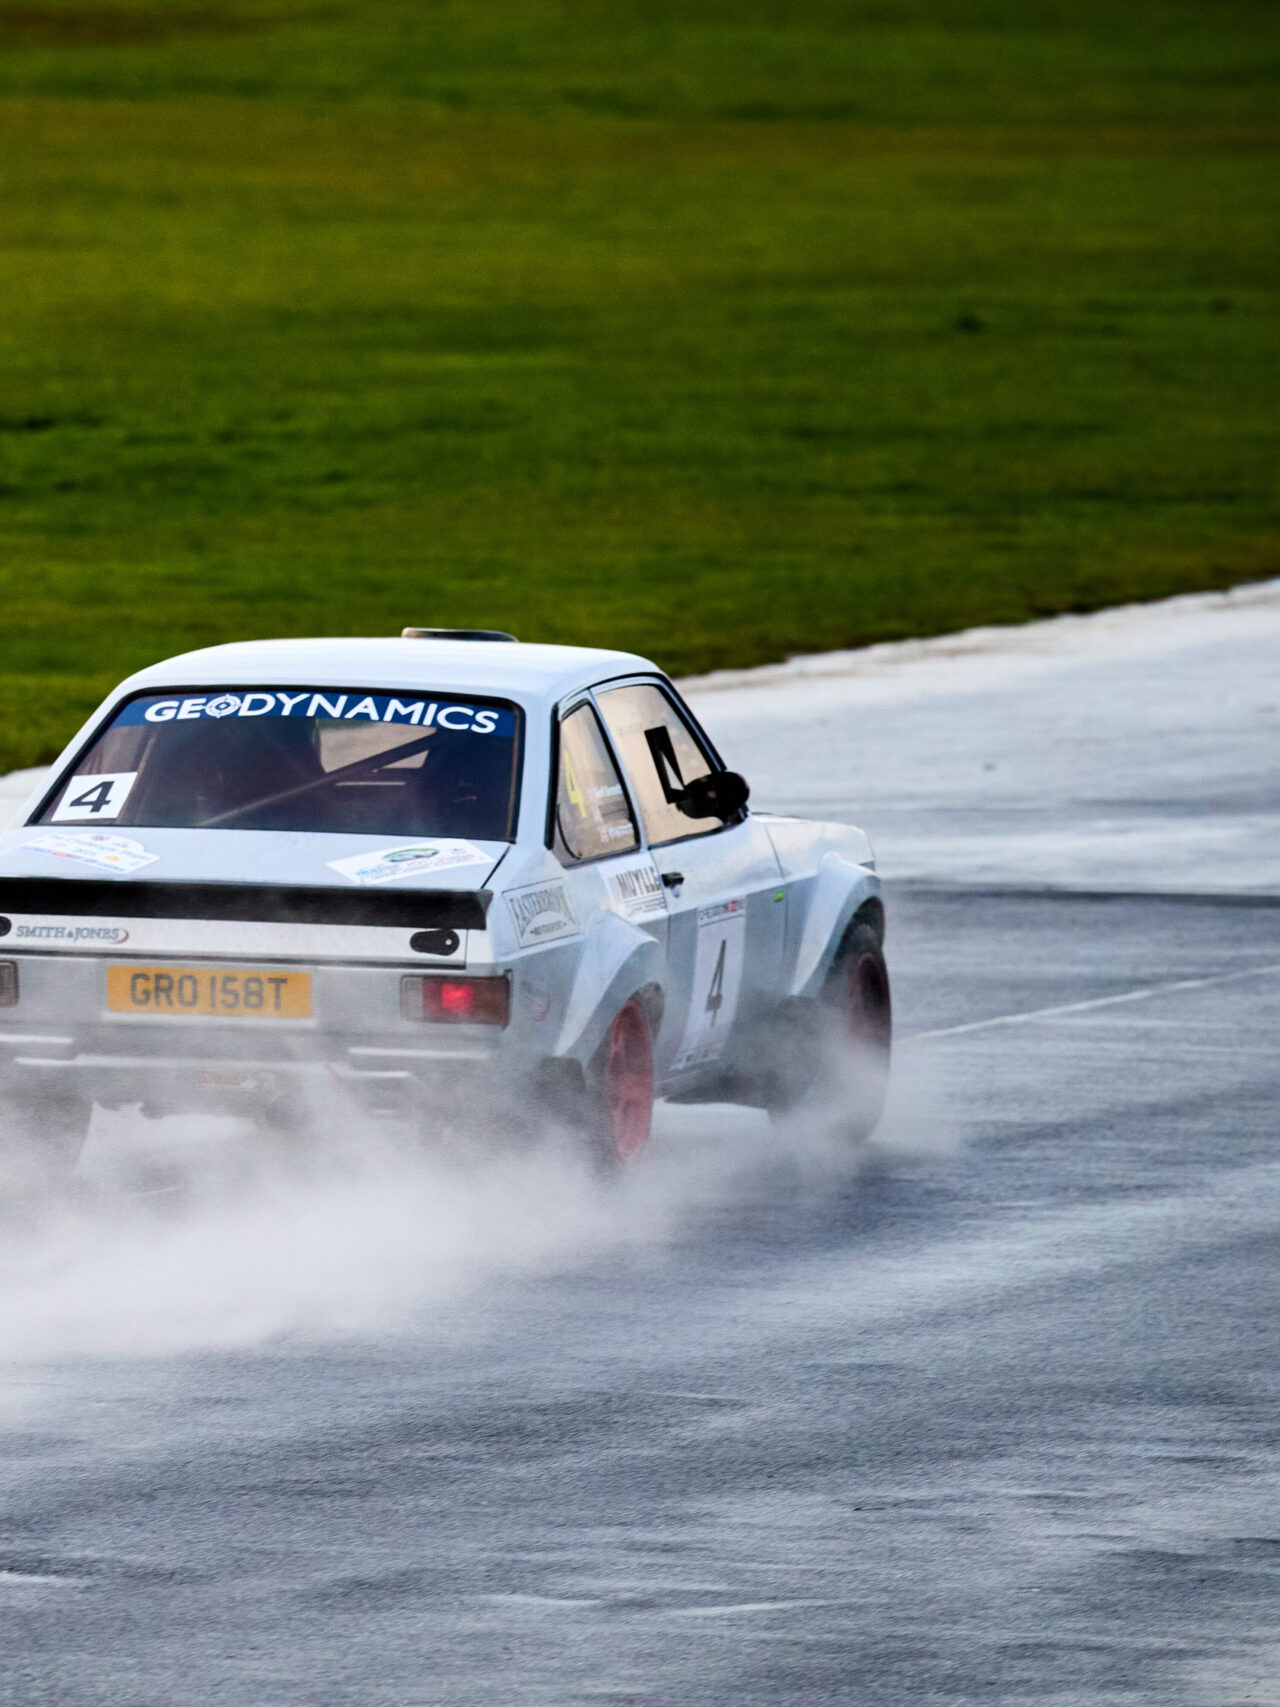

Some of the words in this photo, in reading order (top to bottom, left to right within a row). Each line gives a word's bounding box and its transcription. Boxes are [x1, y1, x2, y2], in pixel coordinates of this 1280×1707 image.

[144, 693, 499, 734] GEODYNAMICS
[69, 780, 115, 813] 4
[563, 750, 586, 818] 4
[130, 972, 198, 1006] GRO
[208, 976, 288, 1010] 158T
[705, 939, 727, 1028] 4
